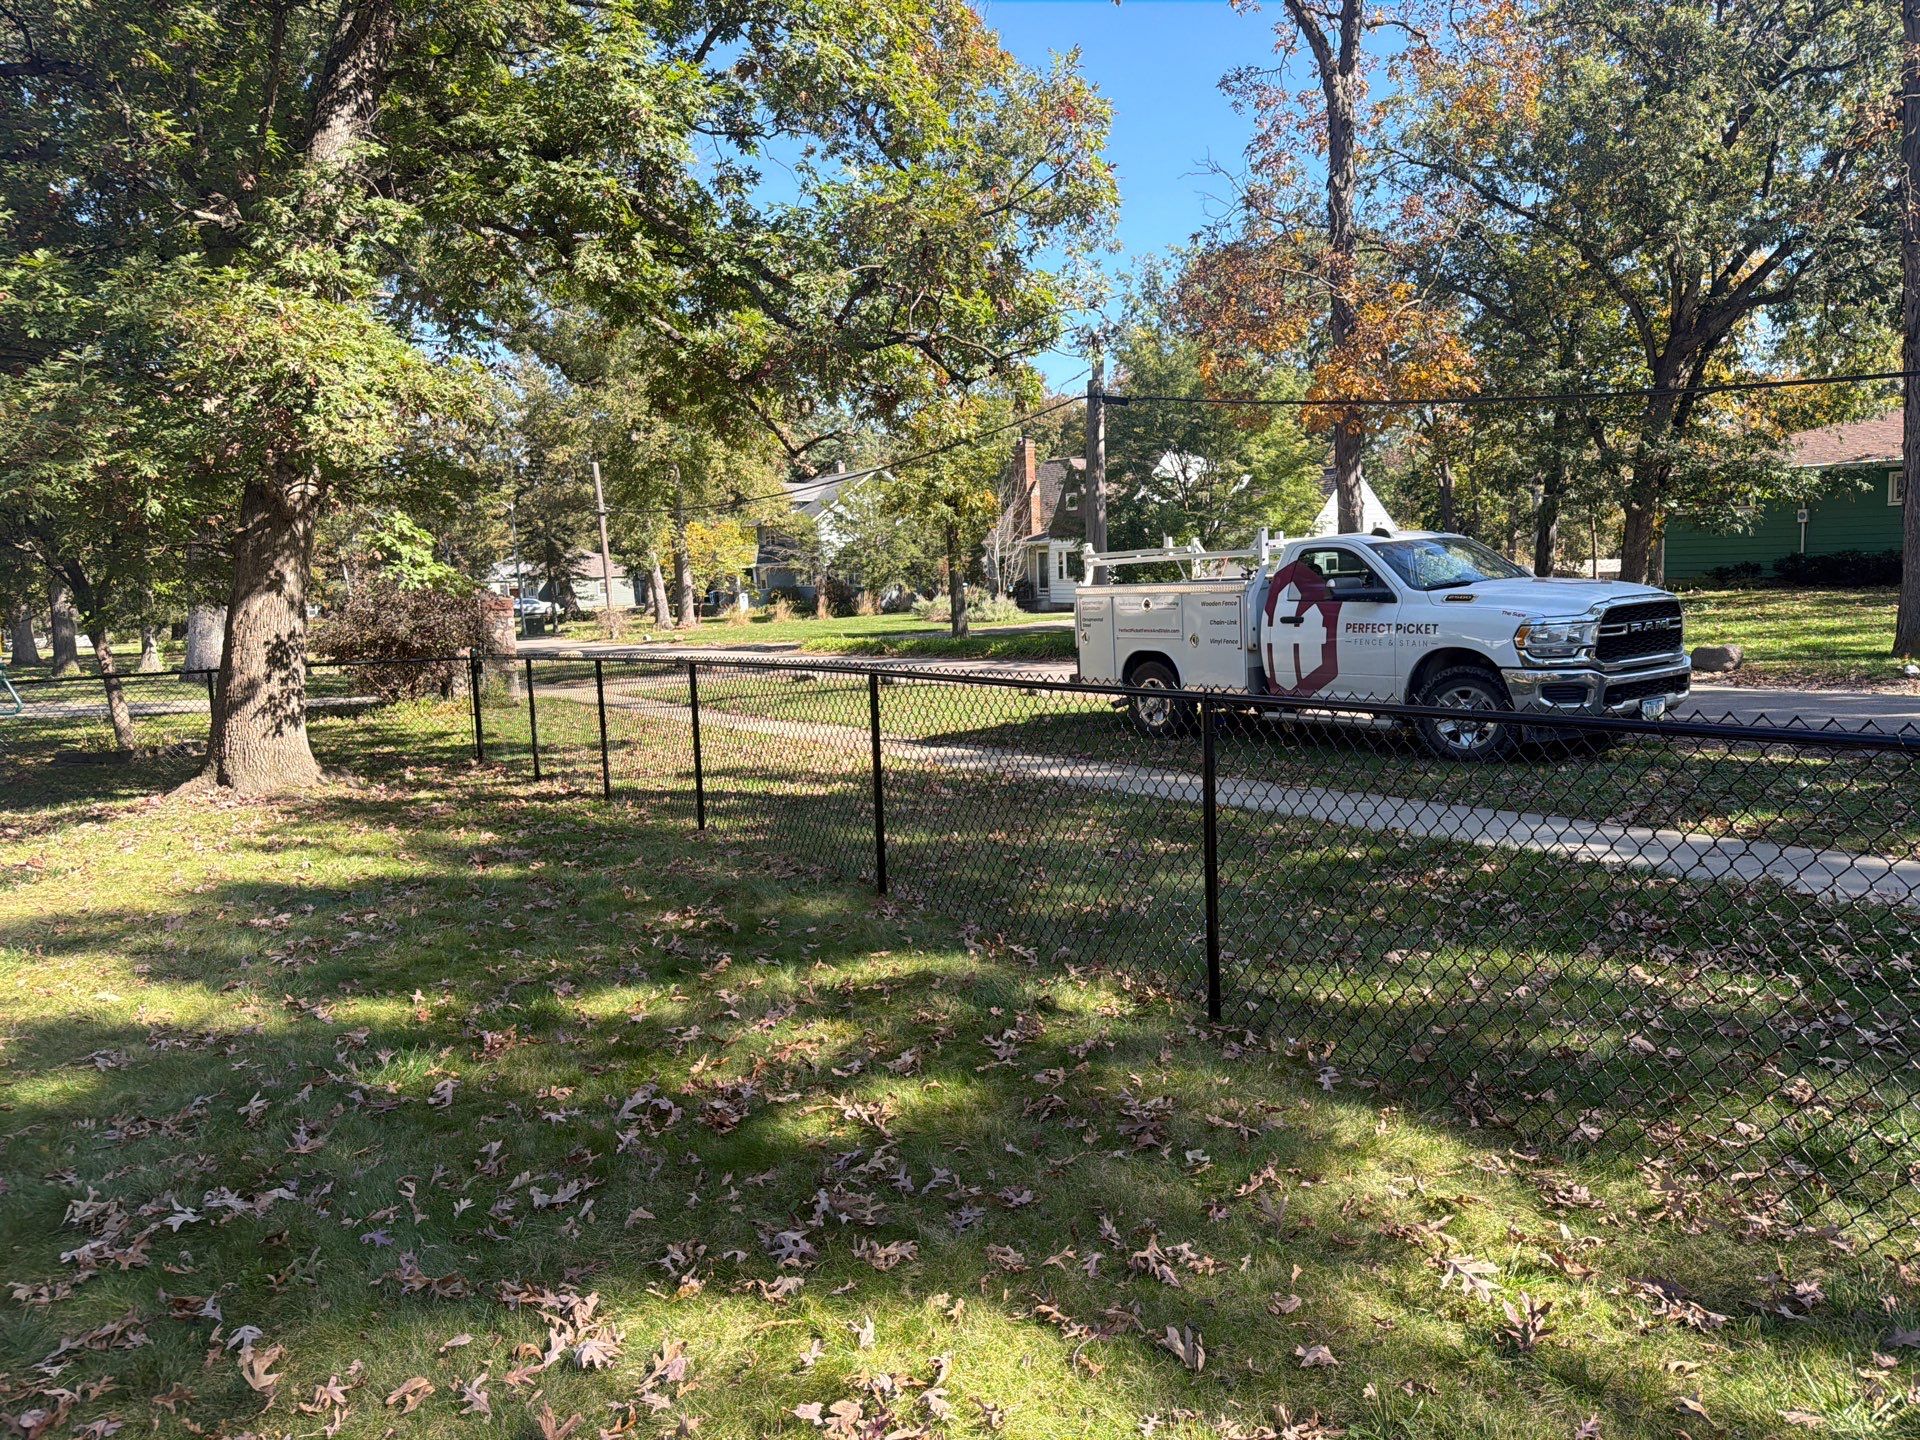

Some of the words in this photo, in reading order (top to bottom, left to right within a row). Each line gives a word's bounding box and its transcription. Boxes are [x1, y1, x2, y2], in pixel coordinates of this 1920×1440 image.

[1345, 622, 1393, 634] PERFECT
[1630, 618, 1670, 632] RAM
[1209, 638, 1222, 646] Vinyl
[1354, 638, 1383, 646] FENCE
